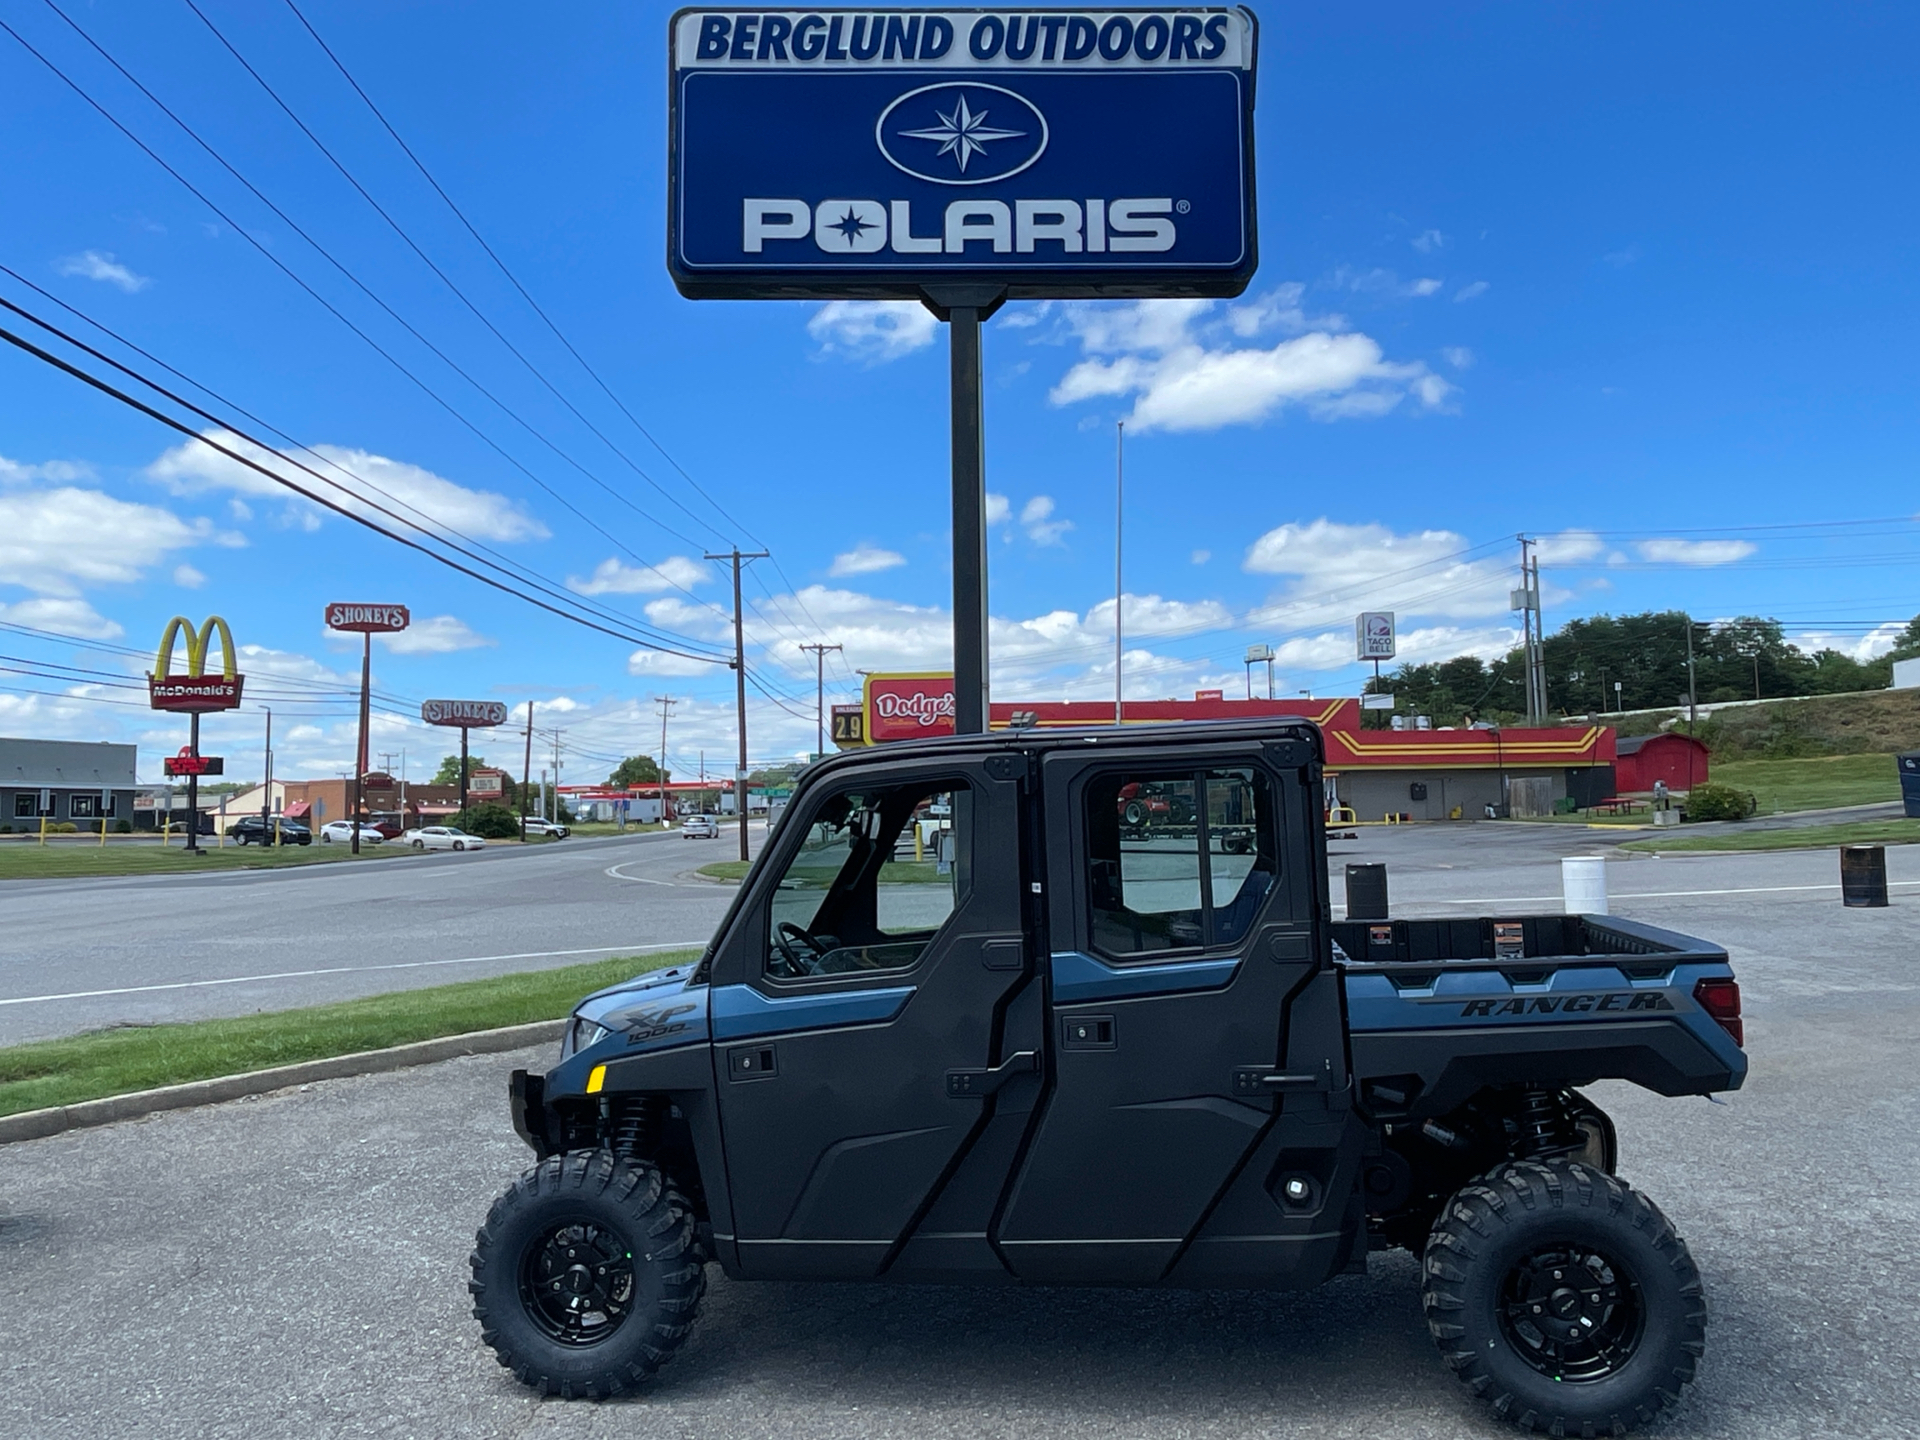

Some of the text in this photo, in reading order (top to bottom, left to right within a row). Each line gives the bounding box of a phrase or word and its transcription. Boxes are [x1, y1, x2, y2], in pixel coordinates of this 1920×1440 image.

[696, 15, 1227, 62] BERGLUND OUTDOORS
[743, 198, 1176, 253] POLARIS
[330, 606, 404, 627] SHONEY'S
[1367, 637, 1392, 645] TACO
[153, 685, 234, 696] McDonald's
[428, 701, 503, 722] SHONEY'S
[1460, 992, 1674, 1017] RANGER
[627, 1023, 687, 1043] 1000
